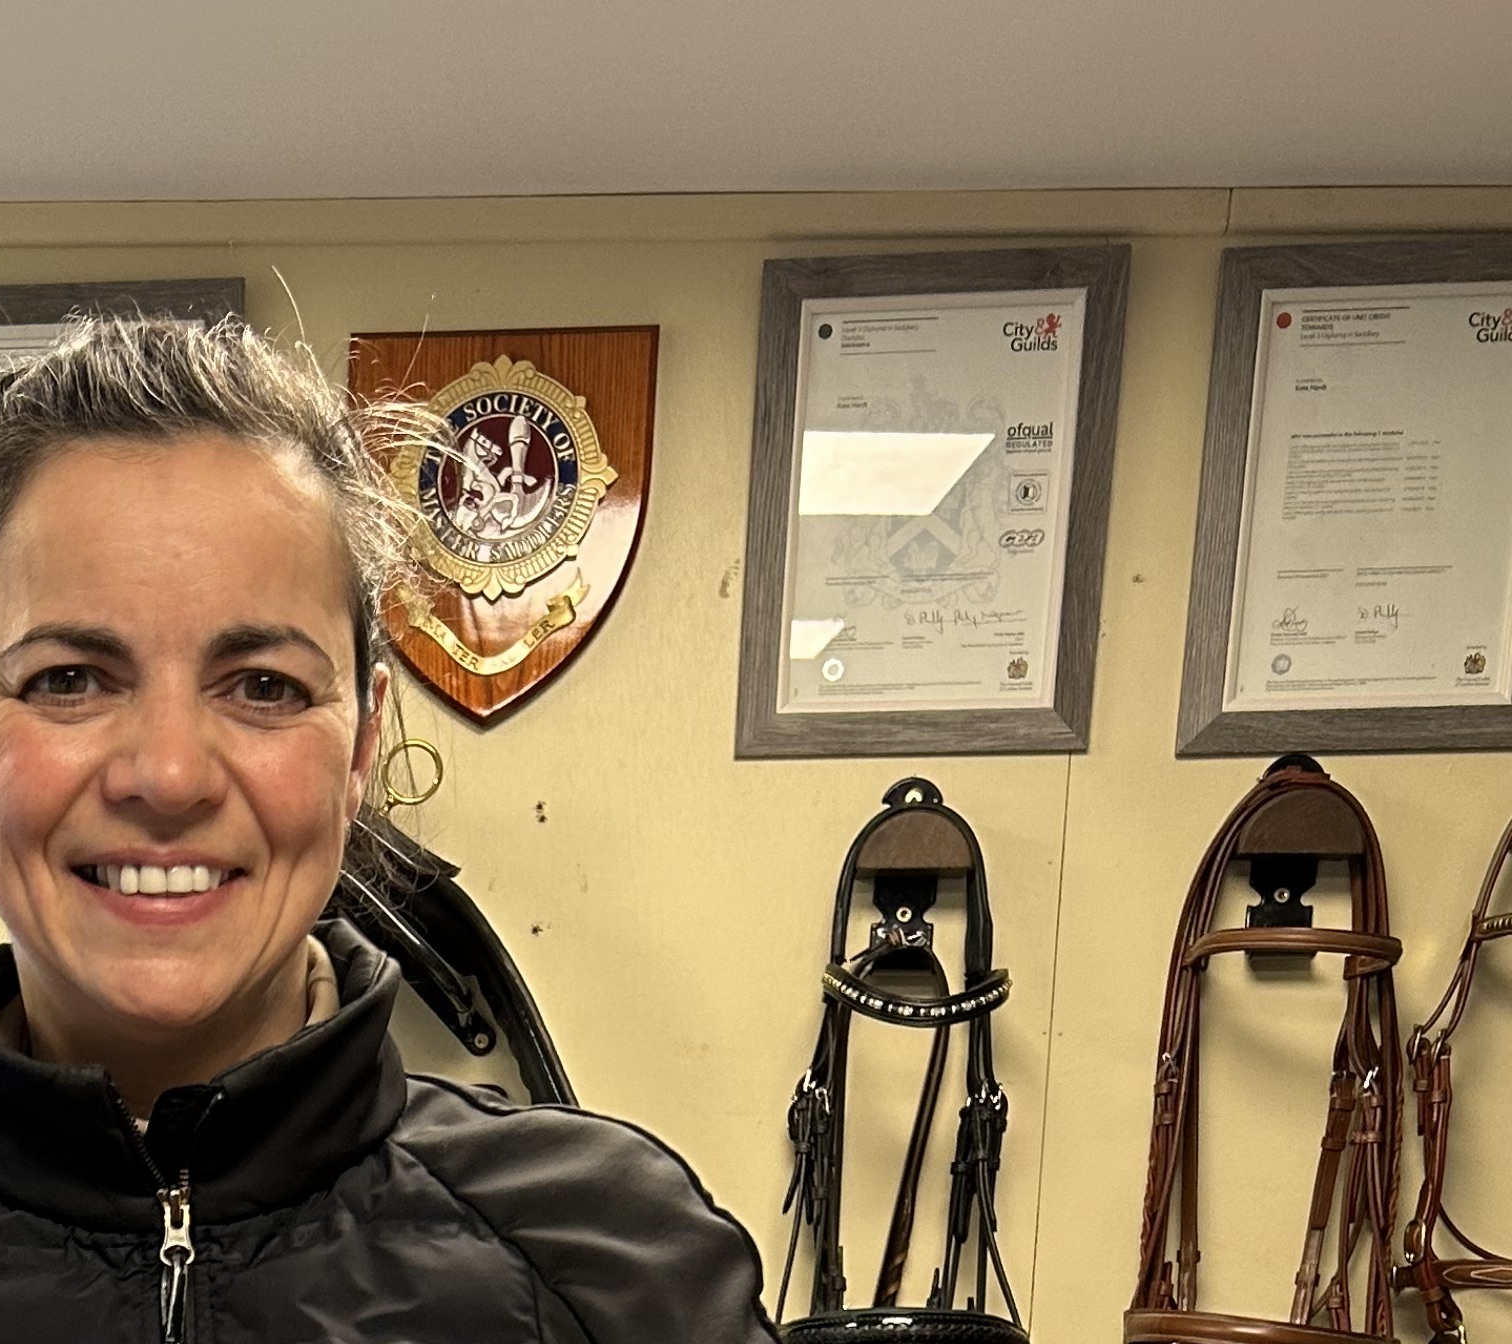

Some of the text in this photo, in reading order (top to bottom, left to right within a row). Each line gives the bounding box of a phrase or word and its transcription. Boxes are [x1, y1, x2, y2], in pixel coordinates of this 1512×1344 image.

[1468, 311, 1501, 330] City
[1003, 321, 1034, 340] City
[1010, 336, 1058, 352] Guilds
[462, 393, 559, 430] SOCIETY
[553, 432, 576, 462] OF
[1007, 421, 1053, 440] ofqual
[421, 487, 479, 560] MASTER
